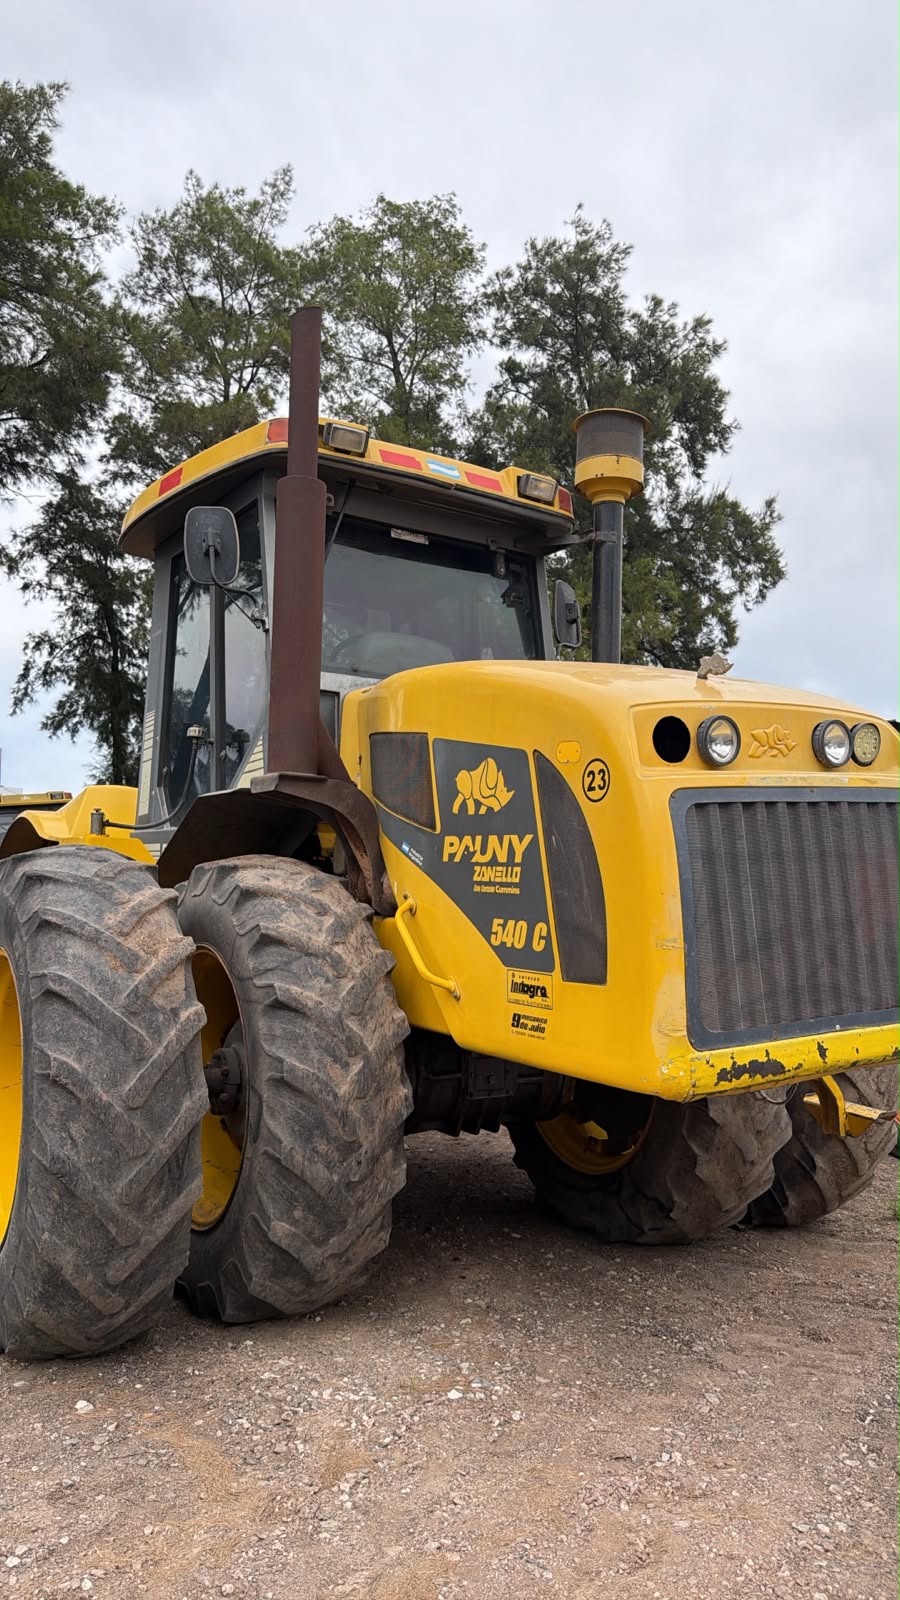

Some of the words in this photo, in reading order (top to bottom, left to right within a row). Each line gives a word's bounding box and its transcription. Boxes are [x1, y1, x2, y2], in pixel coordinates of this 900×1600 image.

[587, 769, 606, 792] 23
[442, 834, 534, 863] PAUNY
[473, 866, 521, 883] ZANELLO
[495, 885, 520, 894] Cummins
[490, 918, 528, 949] 540
[532, 922, 548, 952] C
[511, 1013, 521, 1027] 9
[520, 1021, 529, 1030] de
[529, 1023, 546, 1033] Julio
